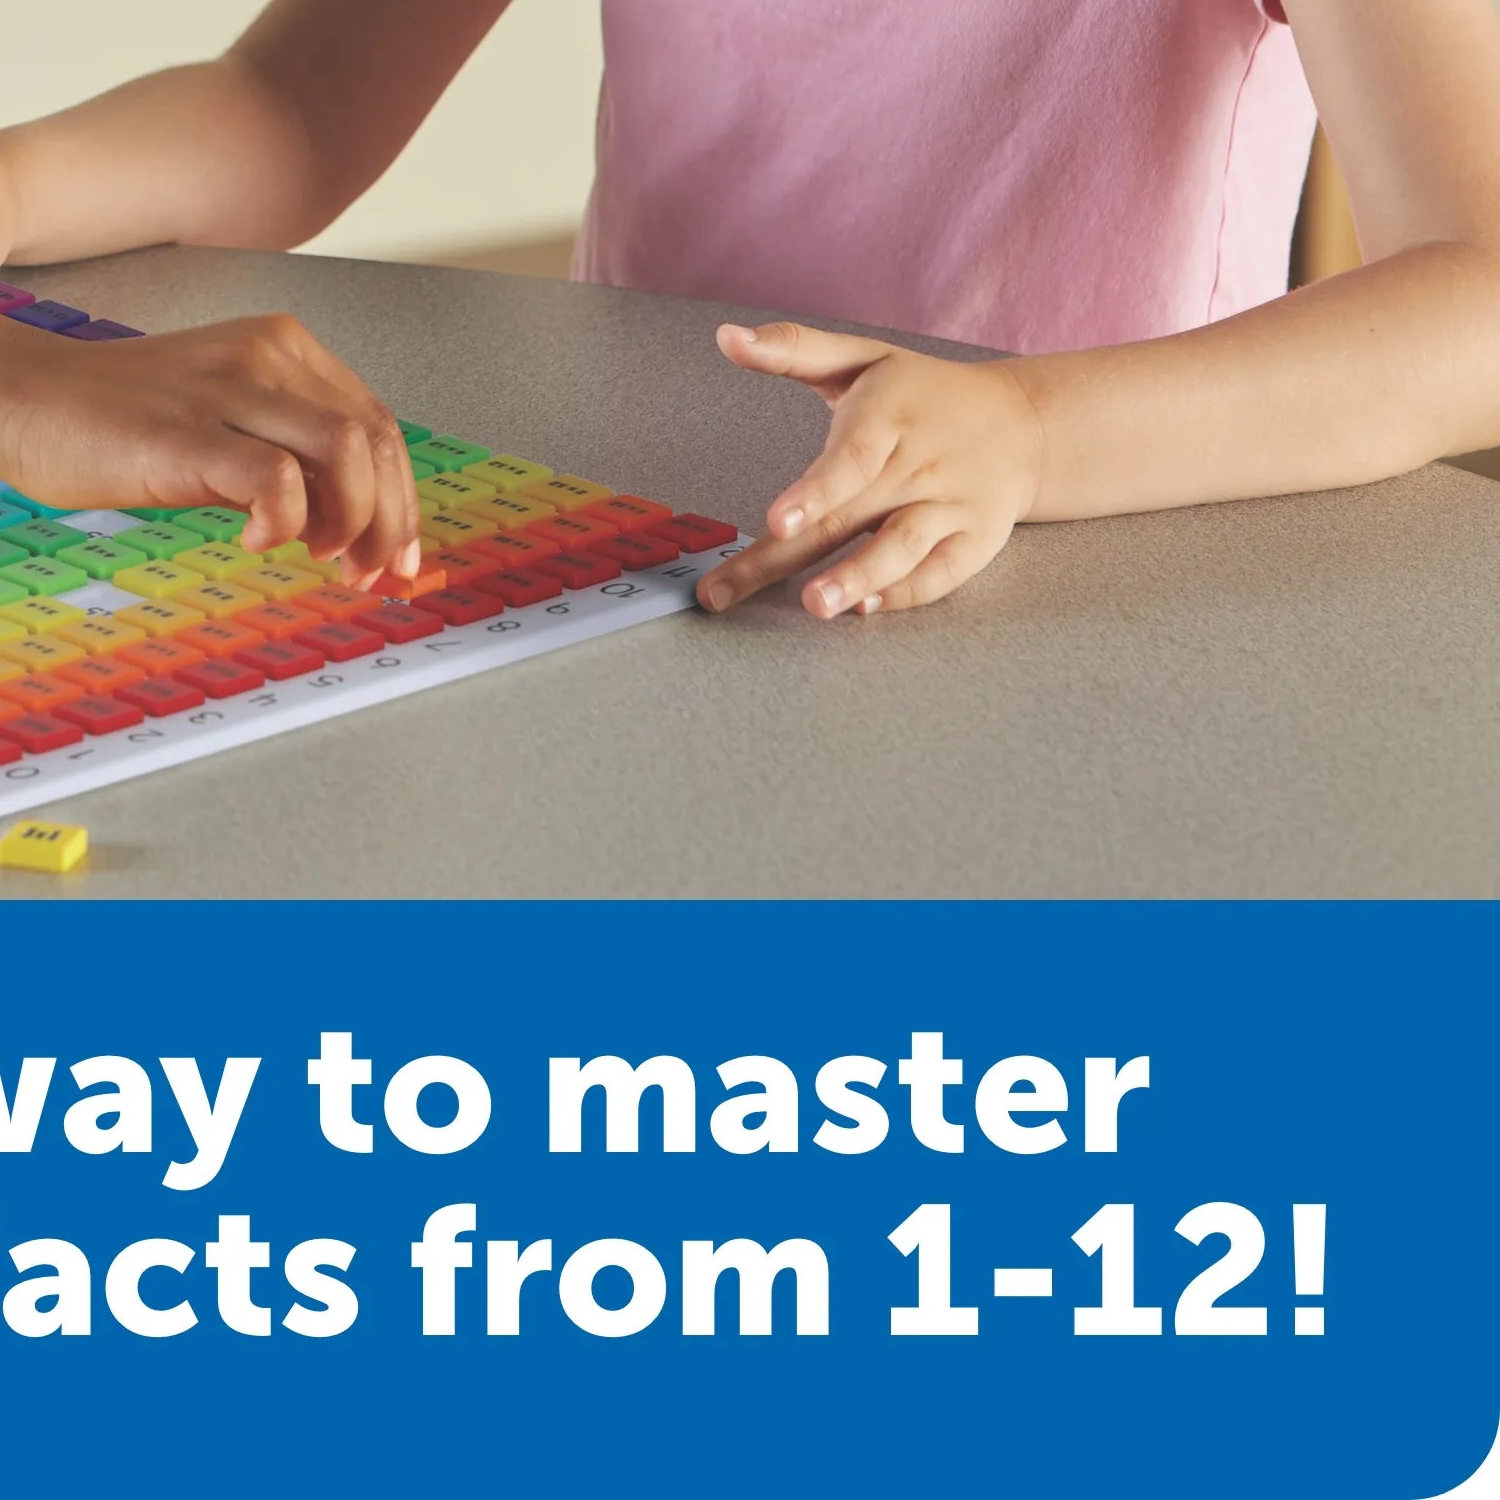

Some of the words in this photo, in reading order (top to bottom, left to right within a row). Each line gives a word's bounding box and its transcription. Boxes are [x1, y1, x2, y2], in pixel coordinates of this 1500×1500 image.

[661, 566, 697, 578] 11
[600, 583, 644, 598] 10
[487, 621, 521, 633] 8
[425, 640, 462, 652] 7
[308, 675, 343, 687] 5
[248, 692, 278, 709] 4
[188, 710, 224, 725] 3
[128, 730, 163, 743] 2
[5, 767, 40, 780] 0
